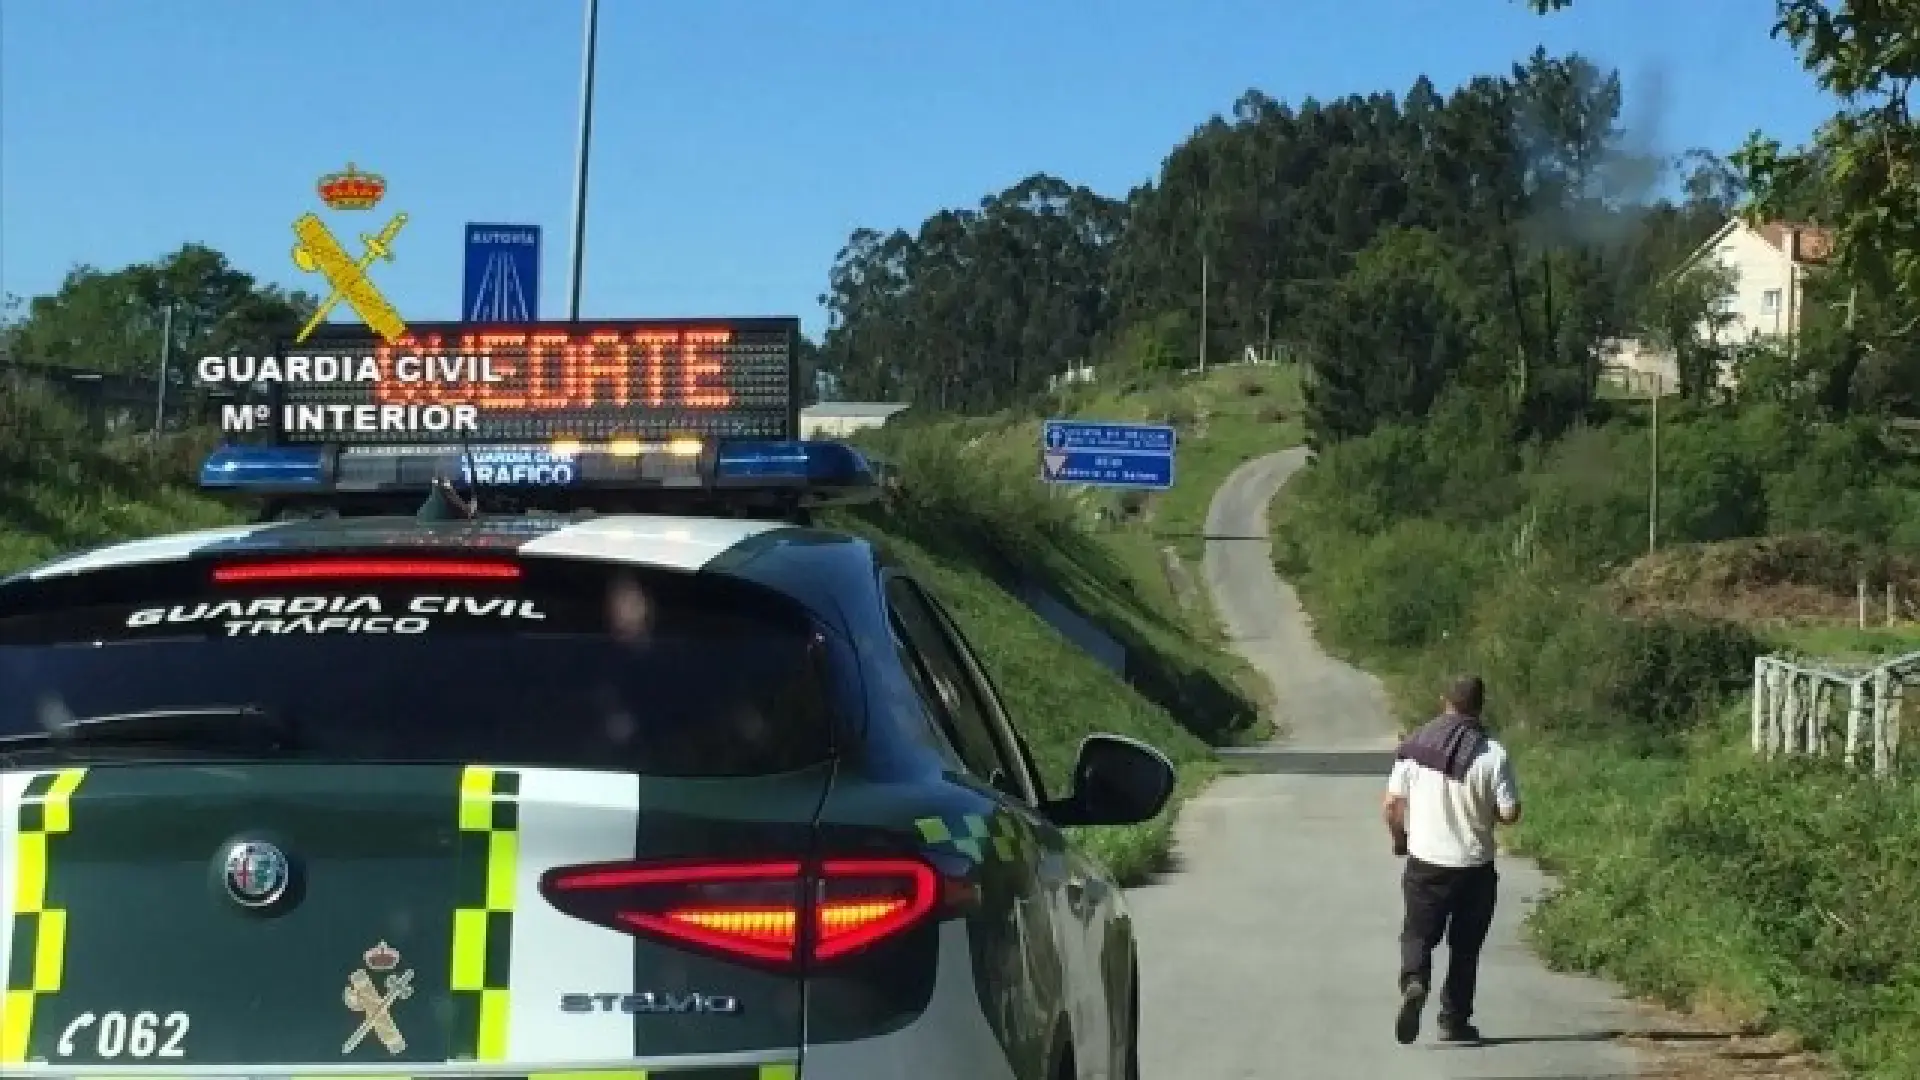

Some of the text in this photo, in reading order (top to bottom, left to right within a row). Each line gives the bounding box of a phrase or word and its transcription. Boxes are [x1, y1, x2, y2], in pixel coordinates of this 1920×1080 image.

[126, 595, 547, 628] GUARDIA CIVIL
[559, 992, 738, 1014] STELVIO
[98, 1010, 190, 1058] 062
